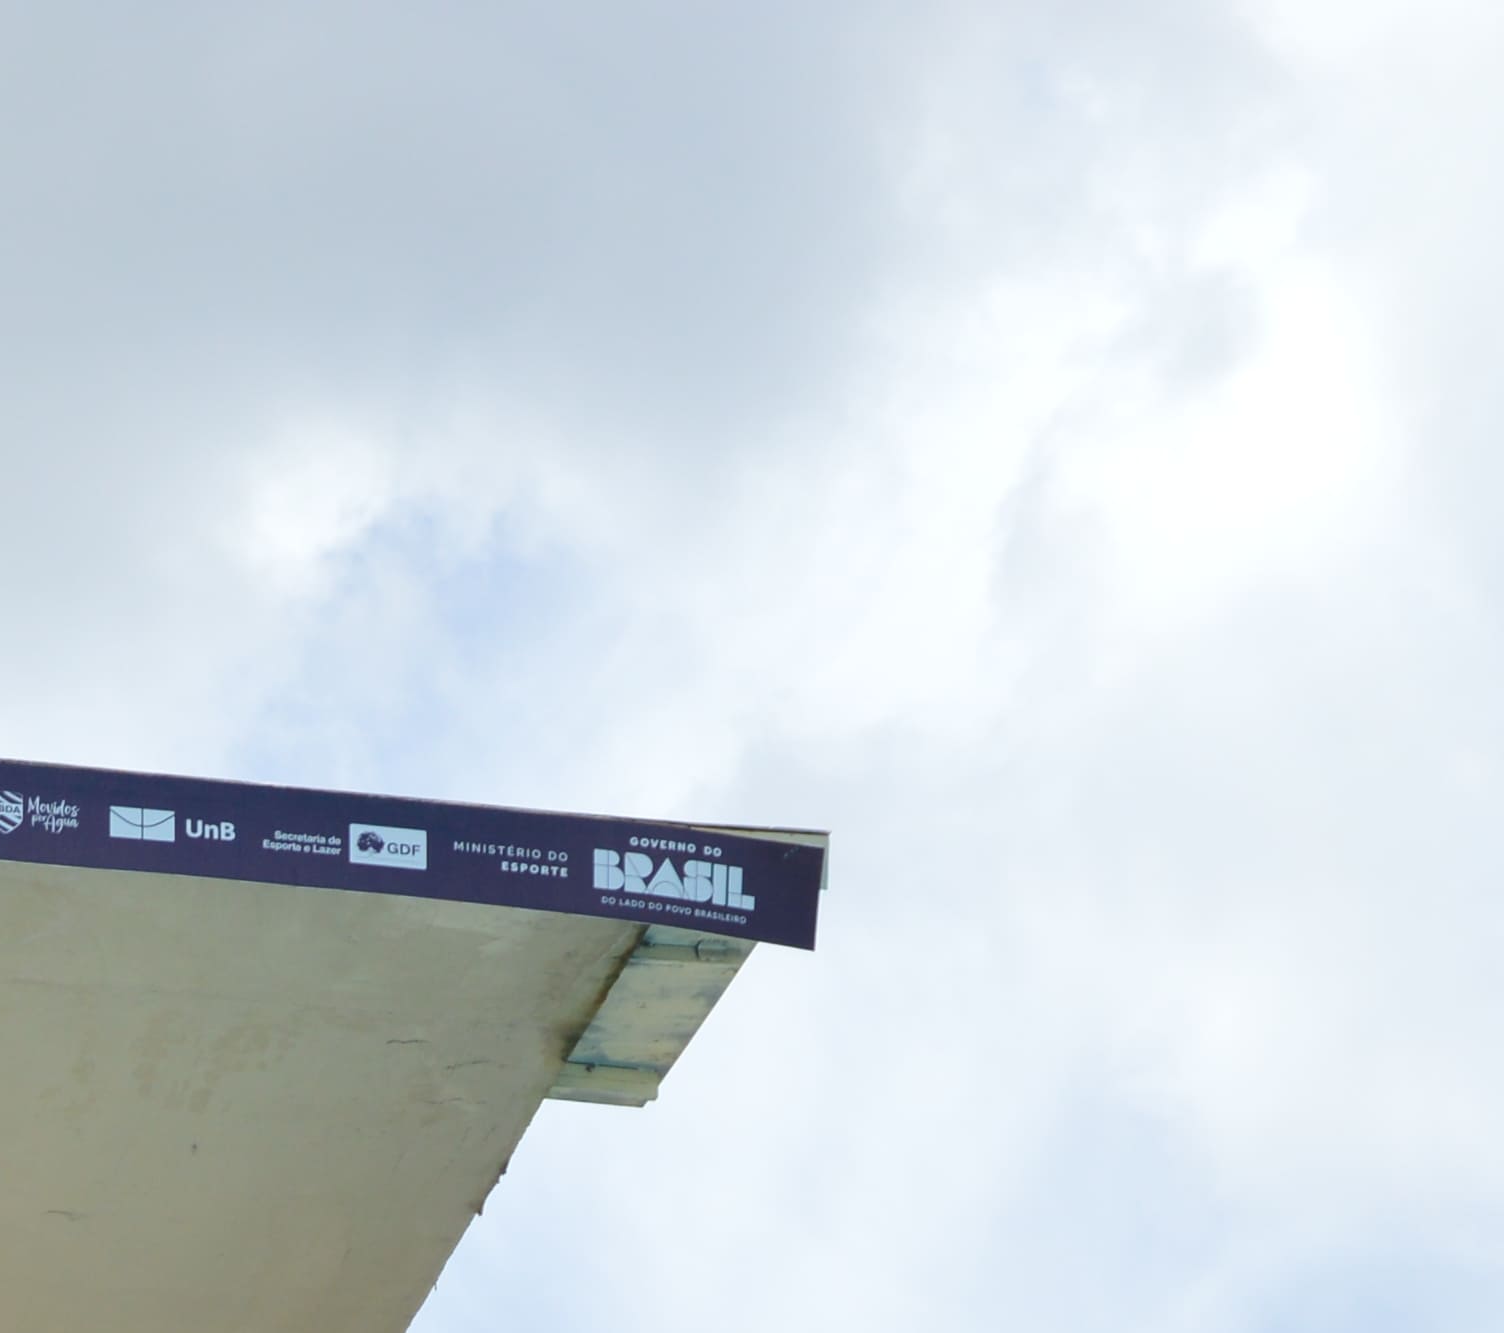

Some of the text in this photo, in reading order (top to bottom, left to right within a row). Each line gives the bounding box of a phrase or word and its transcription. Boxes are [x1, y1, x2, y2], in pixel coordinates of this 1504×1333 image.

[27, 795, 80, 817] Movidos
[185, 818, 236, 841] UnB
[274, 830, 326, 845] Secretaria
[262, 839, 302, 853] Esporte
[312, 844, 341, 856] Lazer
[387, 842, 421, 857] GDF
[453, 840, 569, 862] MINISTÉRIO DO
[630, 836, 722, 857] GOVERNO DO
[501, 860, 569, 878] ESPORTE
[593, 847, 755, 911] BRASIL
[601, 895, 748, 925] DO LADO DO POVO BRASILEIRO
